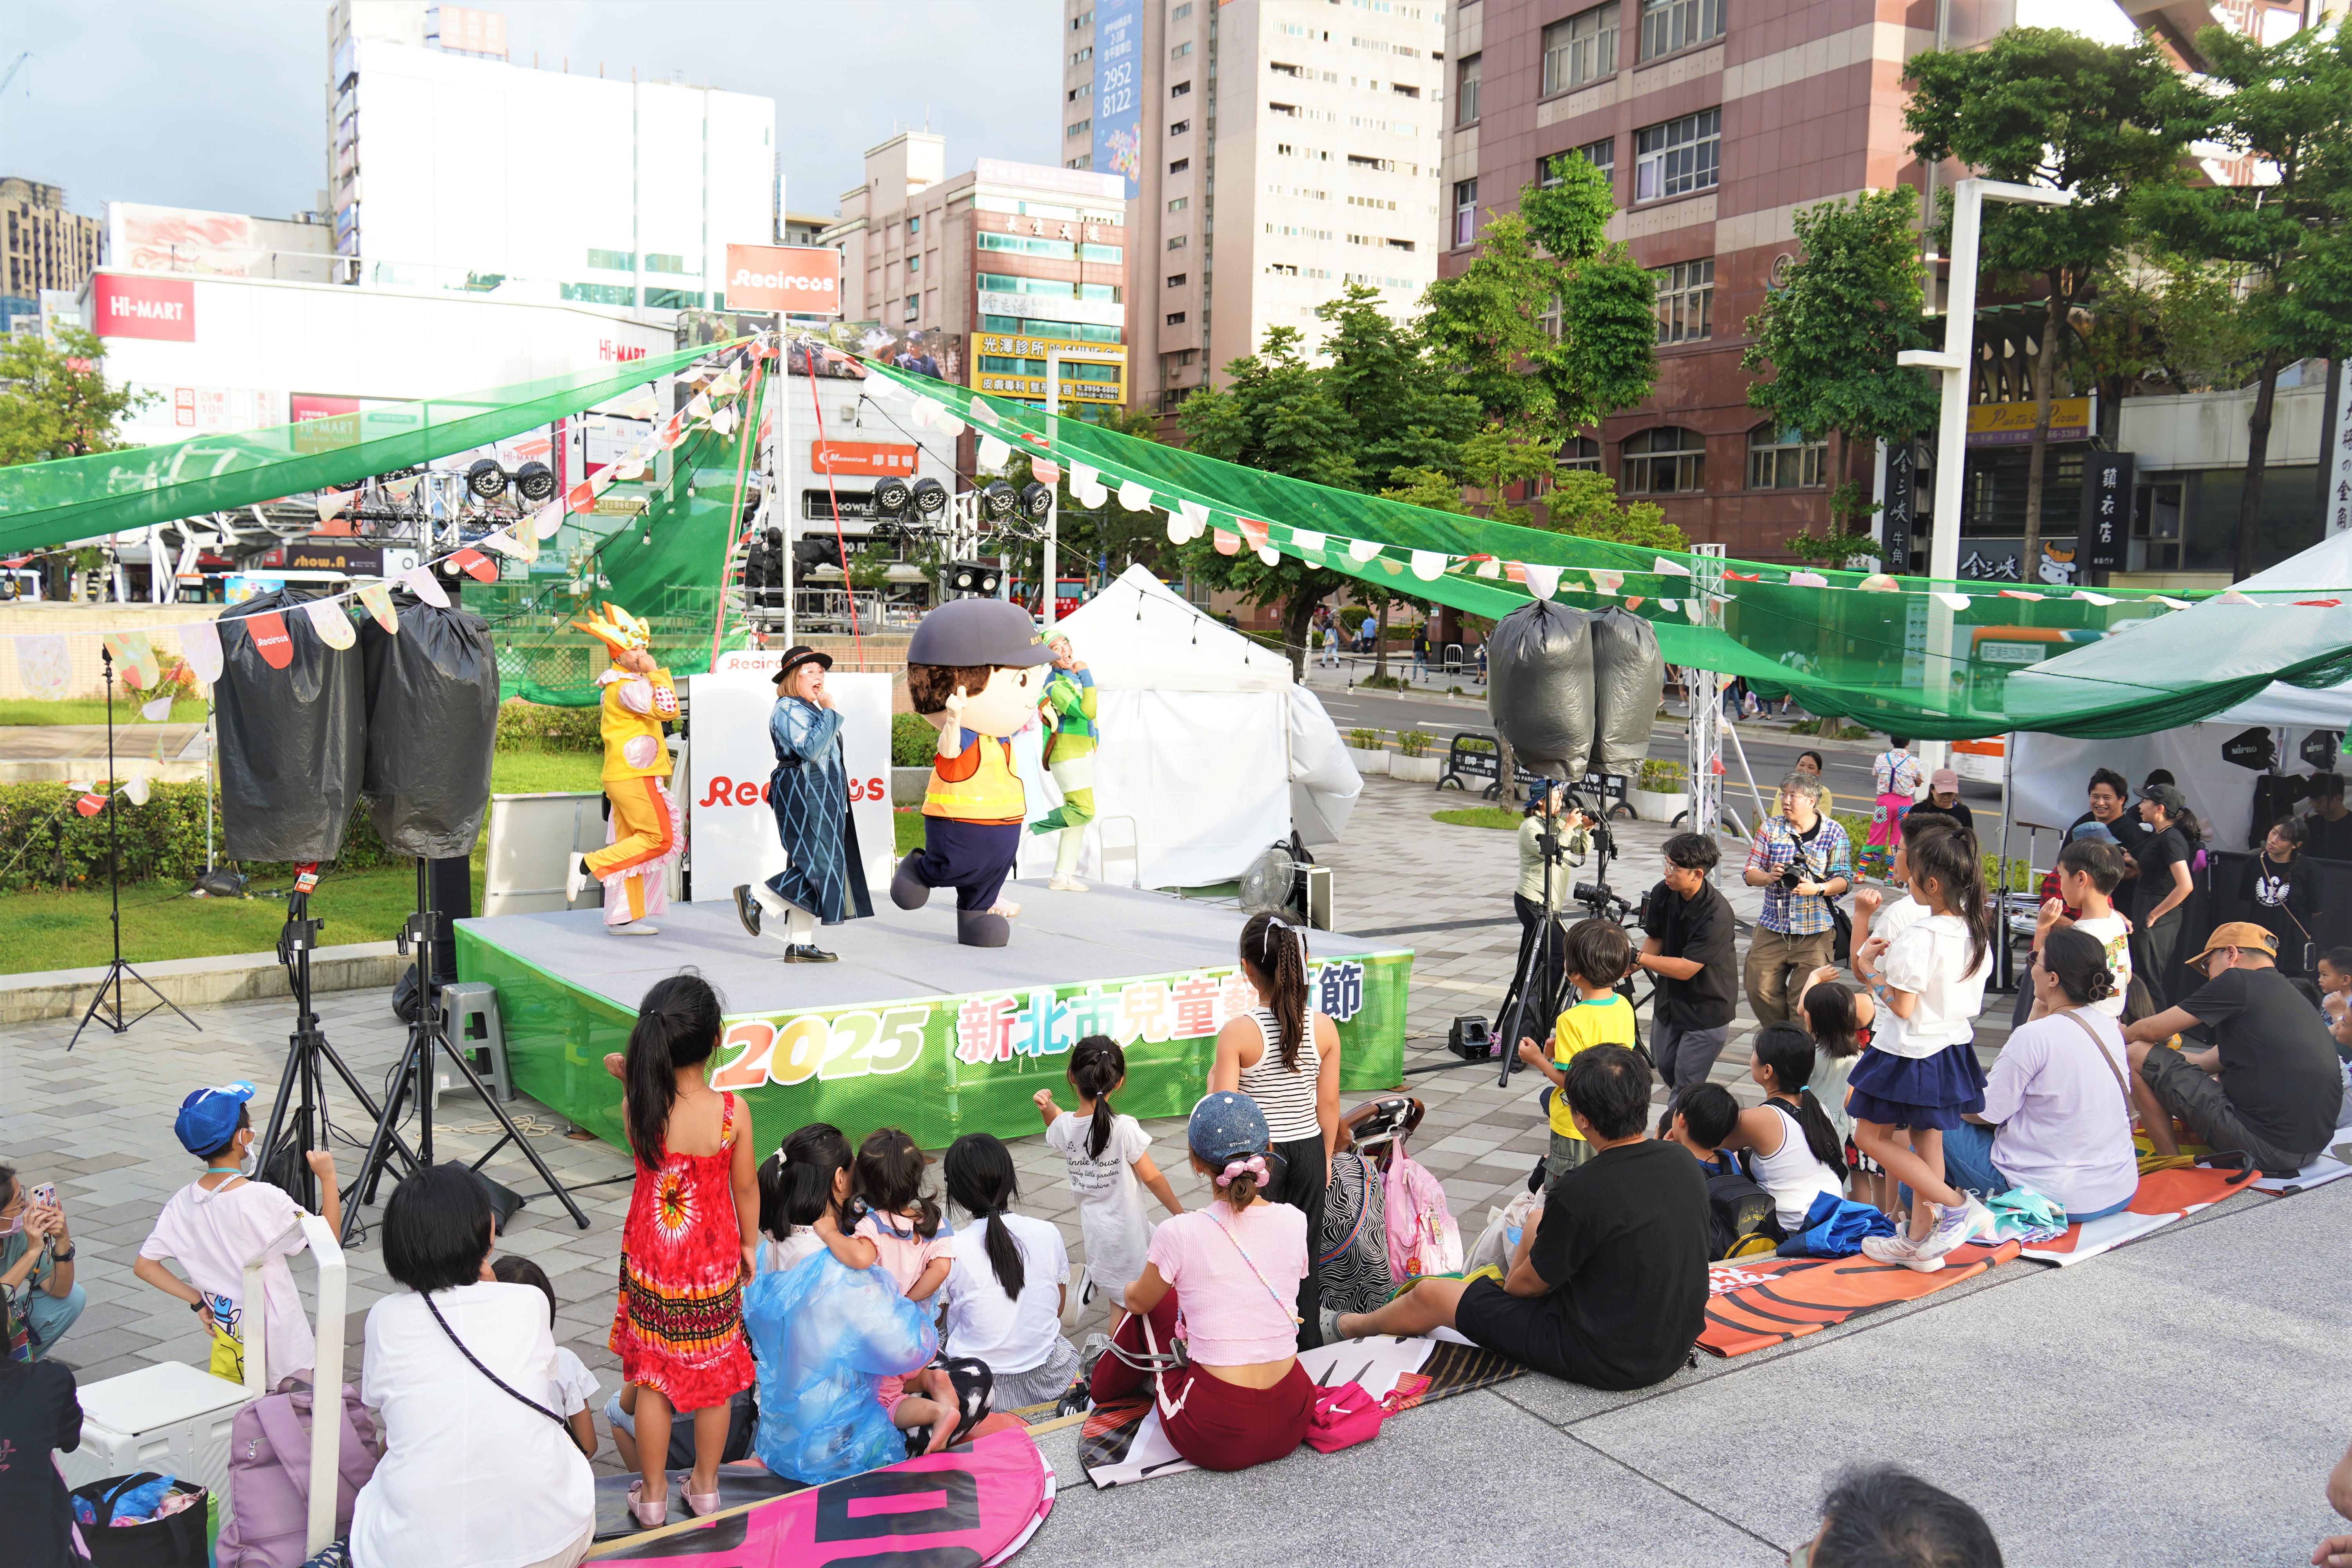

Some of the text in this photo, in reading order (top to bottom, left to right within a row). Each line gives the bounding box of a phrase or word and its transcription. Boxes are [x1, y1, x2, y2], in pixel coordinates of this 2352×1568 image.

[1103, 62, 1131, 93] 2952
[1102, 87, 1131, 117] 8122
[731, 269, 834, 292] Recircus
[983, 336, 1044, 357] 光澤診所
[982, 378, 1073, 396] 皮膚專科 整形容
[177, 389, 194, 426] 招租
[202, 405, 223, 414] 108
[1987, 408, 2027, 427] Pasta
[829, 453, 914, 468] Momentum 摩曼頓
[465, 557, 488, 571] Recircus
[258, 635, 289, 647] Recircus
[727, 657, 783, 670] Recirc
[1466, 766, 1486, 775] PARKING
[714, 964, 1362, 1088] 2025 新北市兒童藝節
[1092, 1157, 1120, 1167] Mouse
[1096, 1170, 1120, 1180] garden
